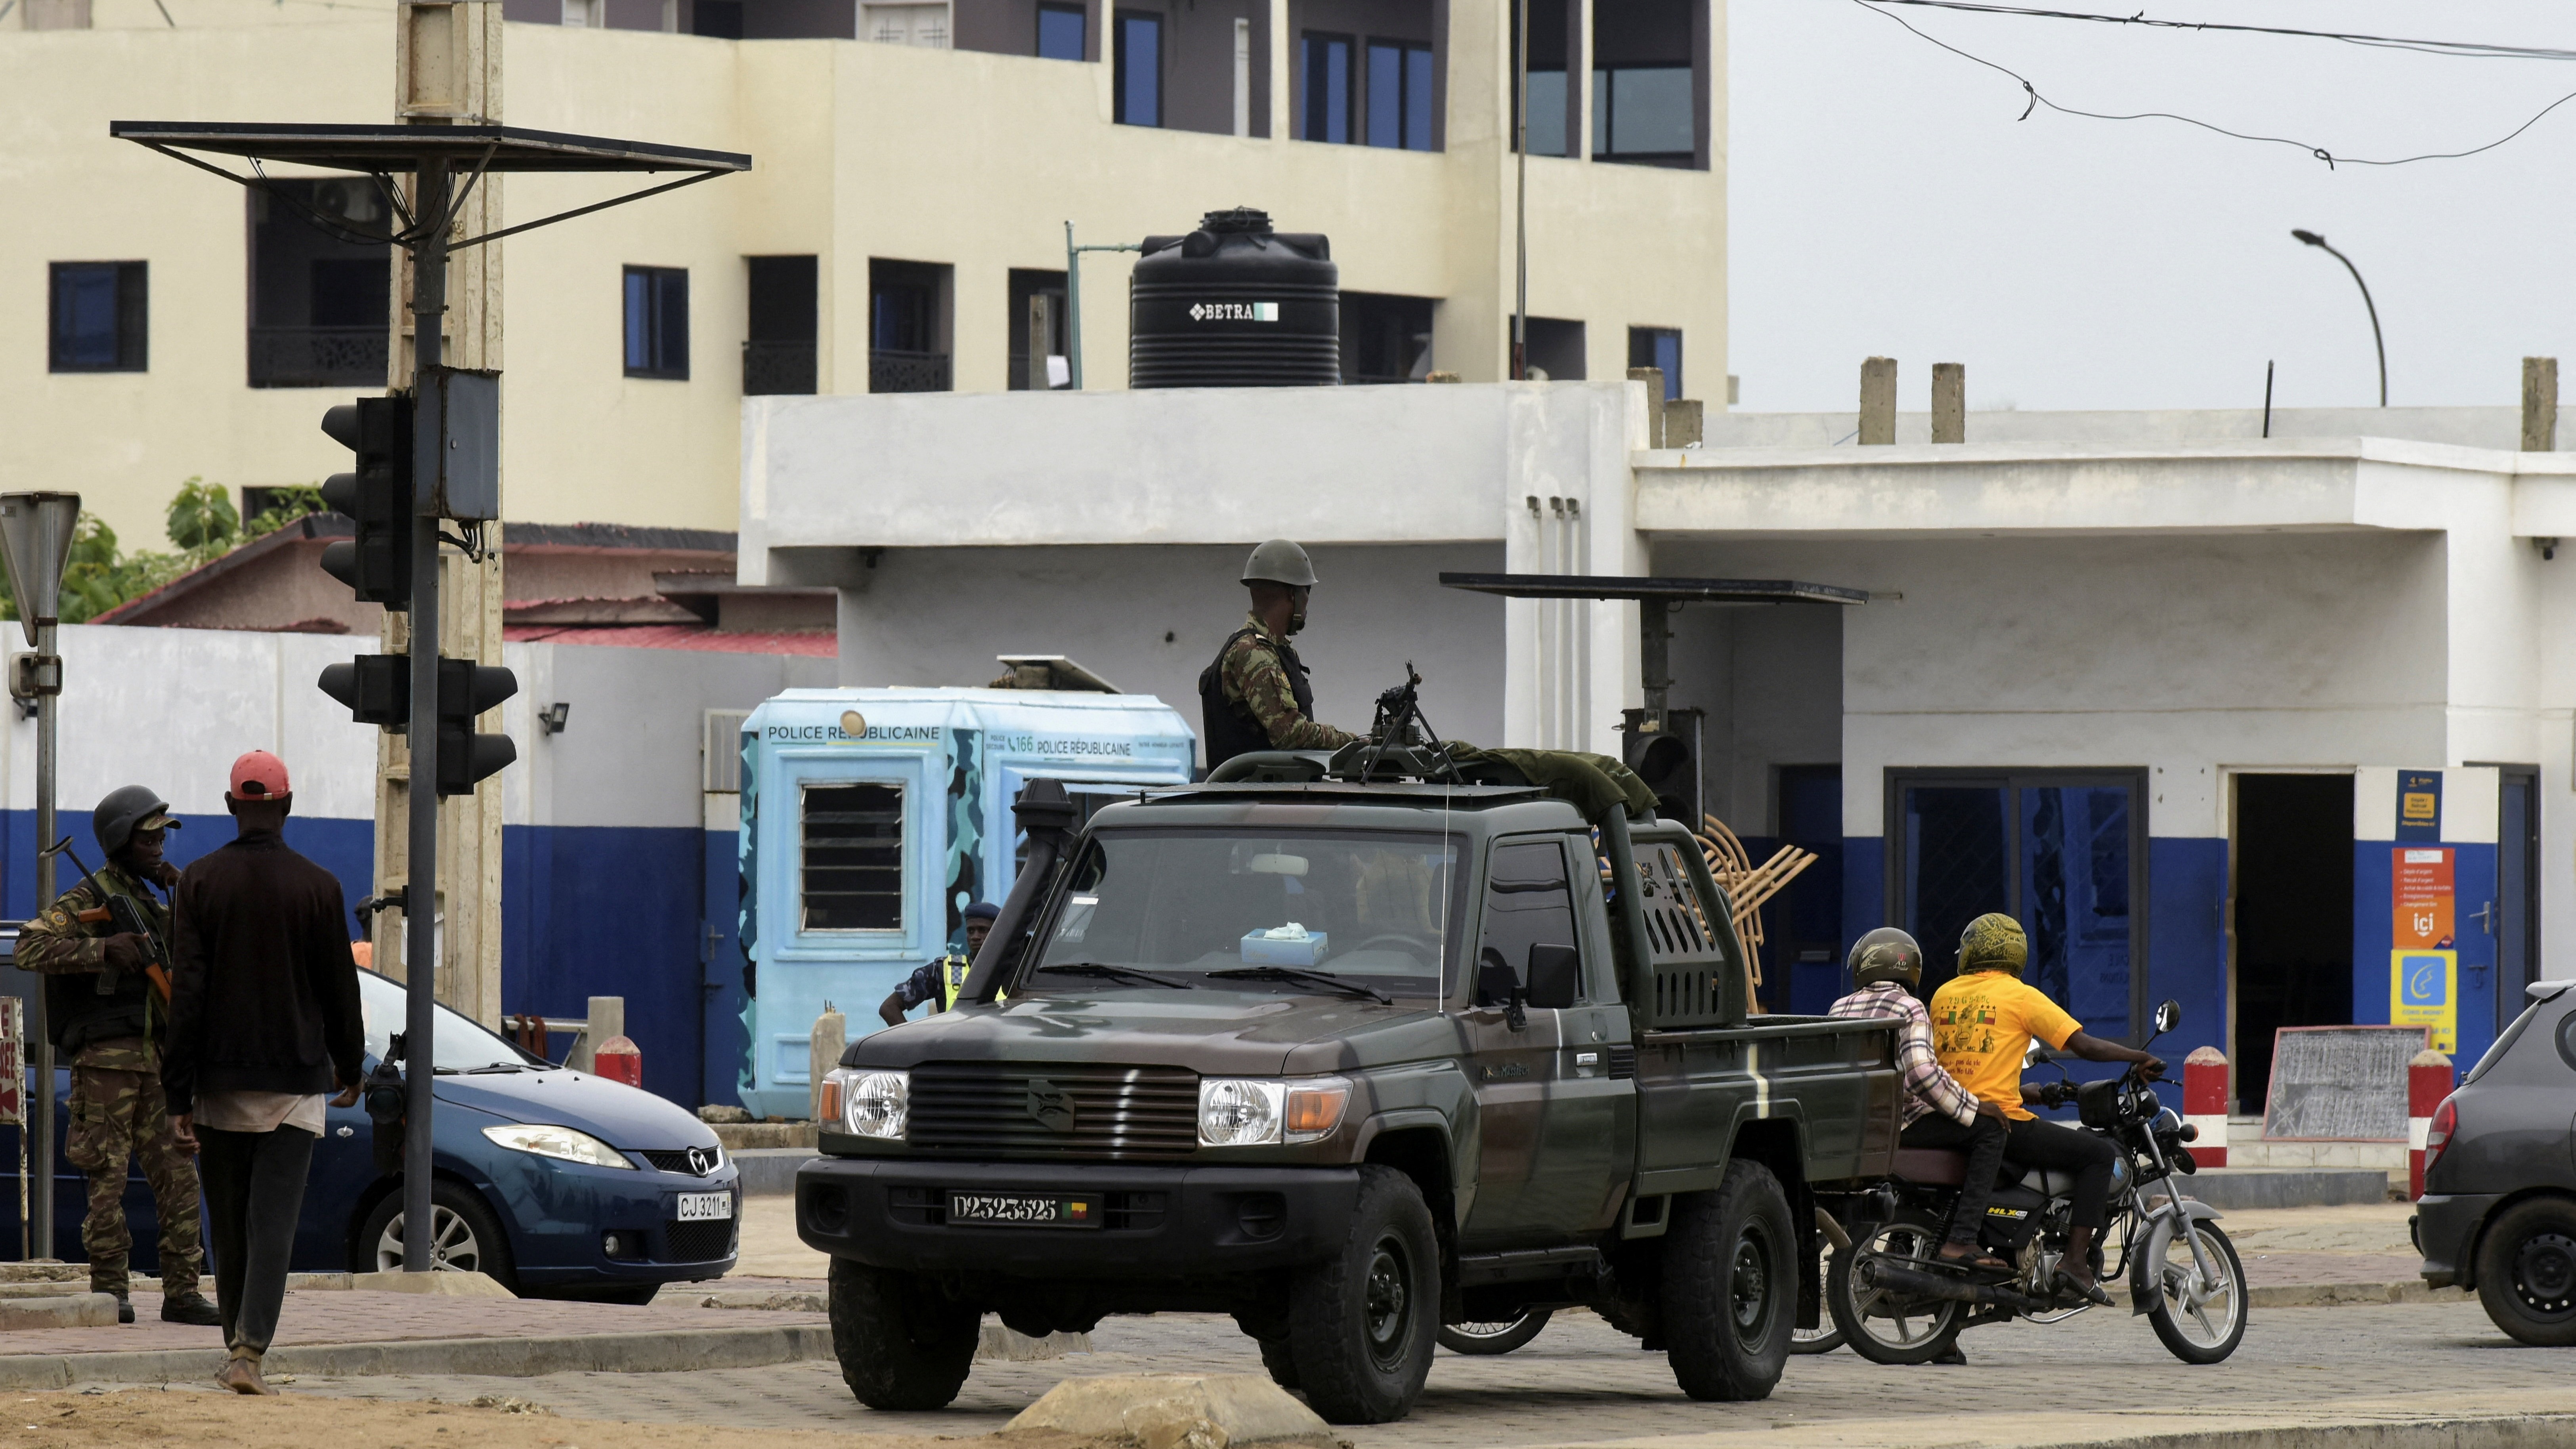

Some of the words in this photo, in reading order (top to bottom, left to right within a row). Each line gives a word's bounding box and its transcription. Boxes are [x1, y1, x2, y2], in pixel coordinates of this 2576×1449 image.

[1206, 304, 1253, 319] BETRA
[768, 726, 823, 739] POLICE
[1016, 736, 1033, 752] 166
[1037, 740, 1068, 754] POLICE
[1070, 738, 1131, 756] RÉPUBLICAINE
[2414, 912, 2433, 931] ici
[681, 1197, 697, 1217] CJ
[700, 1195, 720, 1216] 3211
[1987, 1207, 2017, 1216] HLX
